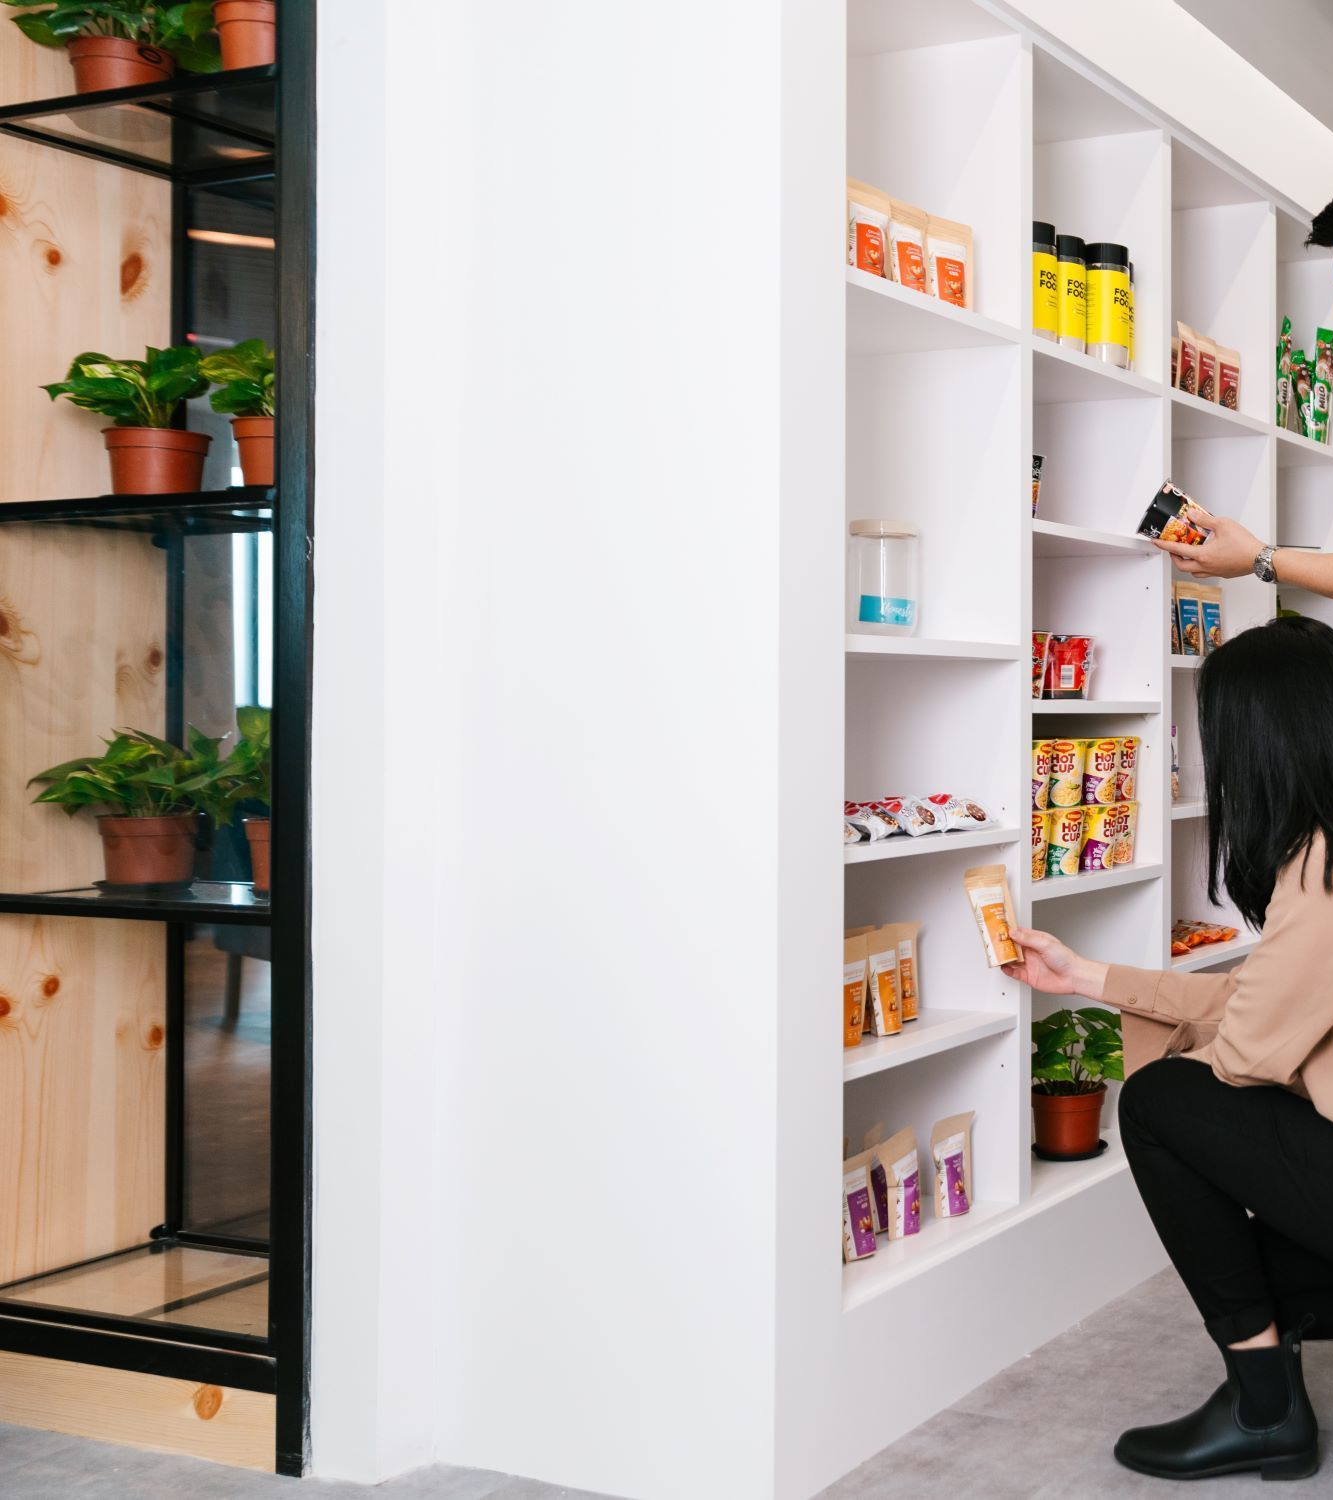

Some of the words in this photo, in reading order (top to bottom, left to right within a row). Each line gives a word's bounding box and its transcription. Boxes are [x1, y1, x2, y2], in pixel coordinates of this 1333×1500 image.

[1037, 754, 1050, 766] HO
[1051, 753, 1075, 764] HOT
[1095, 752, 1116, 763] HOT
[1037, 765, 1050, 776] CU
[1050, 763, 1075, 773] CUP
[1095, 762, 1115, 771] CUP
[1104, 818, 1116, 829] HO
[1117, 814, 1130, 825] OT
[1062, 821, 1082, 833] HOT
[1116, 824, 1129, 834] UP
[1062, 832, 1081, 842] CUP
[1103, 828, 1115, 838] CU
